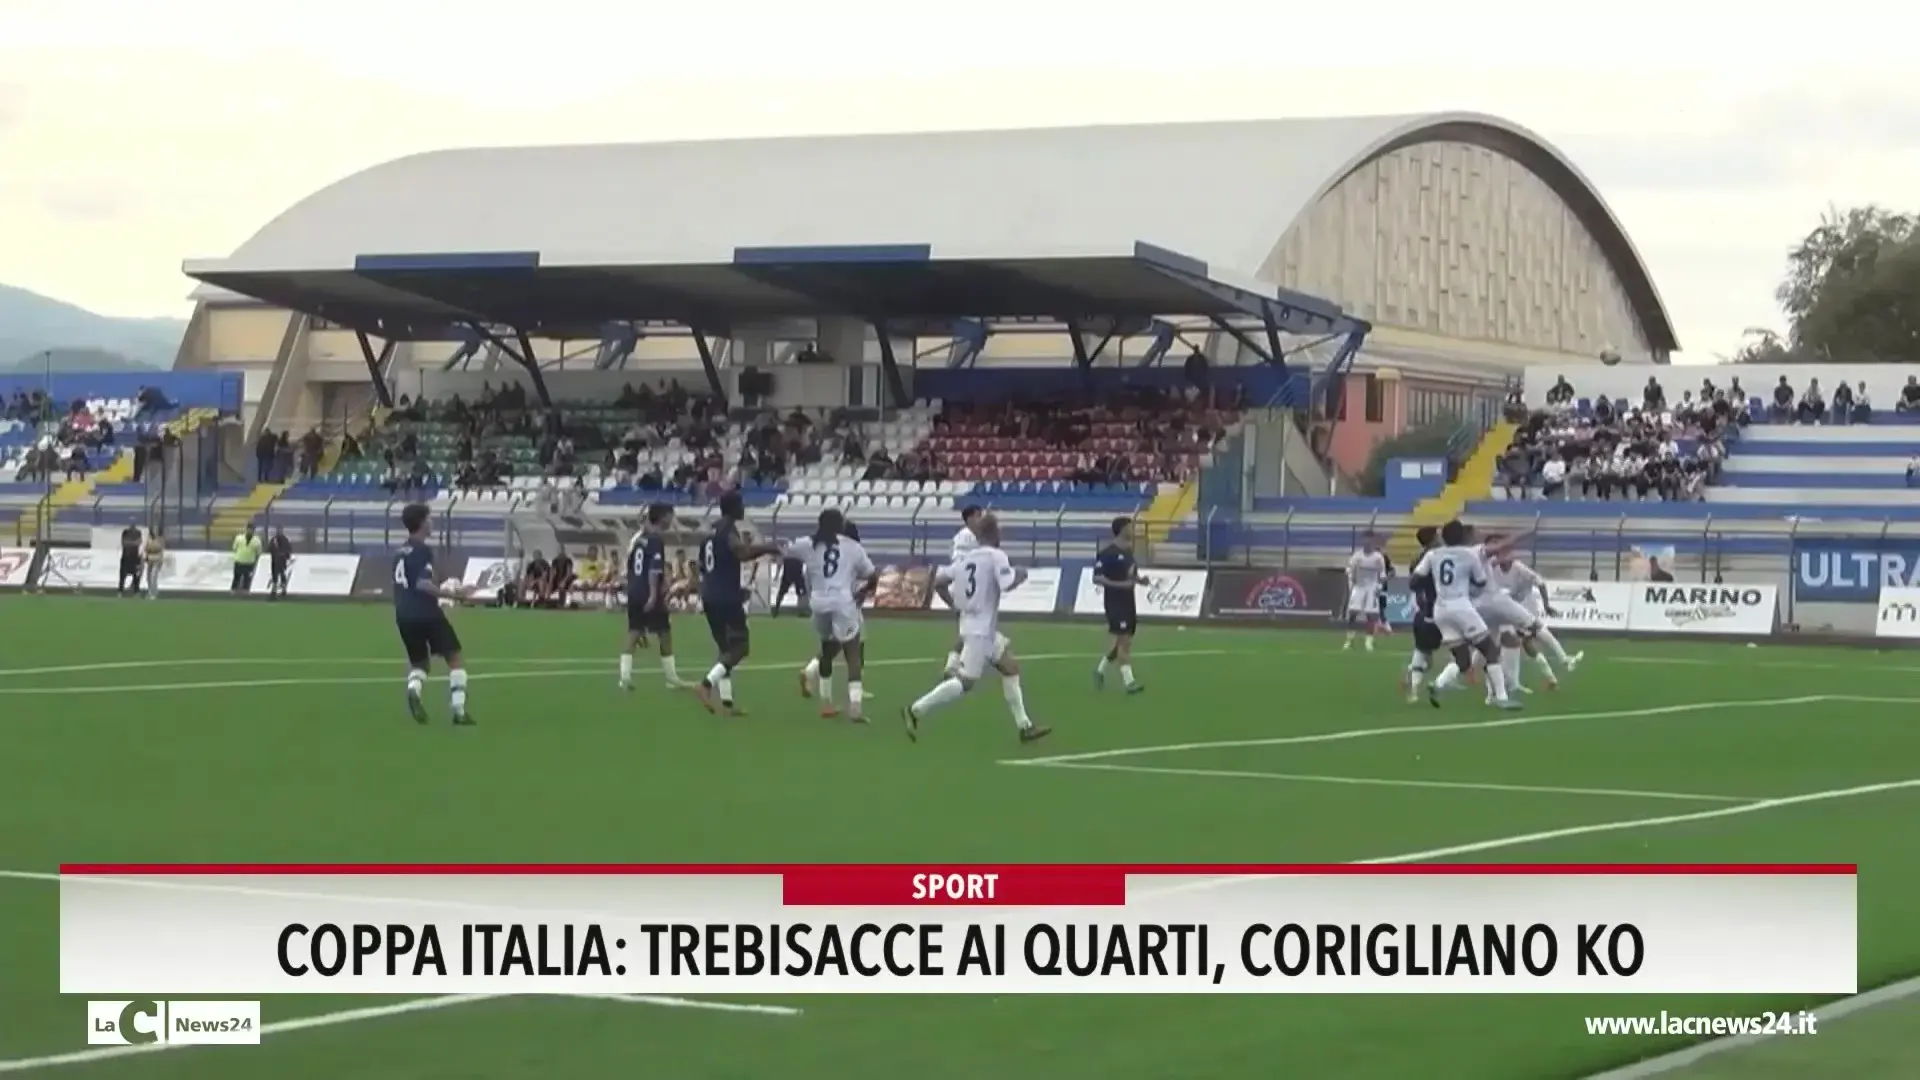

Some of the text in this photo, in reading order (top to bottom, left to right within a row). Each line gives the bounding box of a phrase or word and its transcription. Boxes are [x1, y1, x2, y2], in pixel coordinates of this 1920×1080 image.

[395, 559, 409, 589] 4
[634, 547, 644, 576] 8
[823, 548, 840, 579] 8
[1440, 559, 1454, 585] 6
[965, 562, 976, 598] 3
[1645, 587, 1762, 606] MARINO
